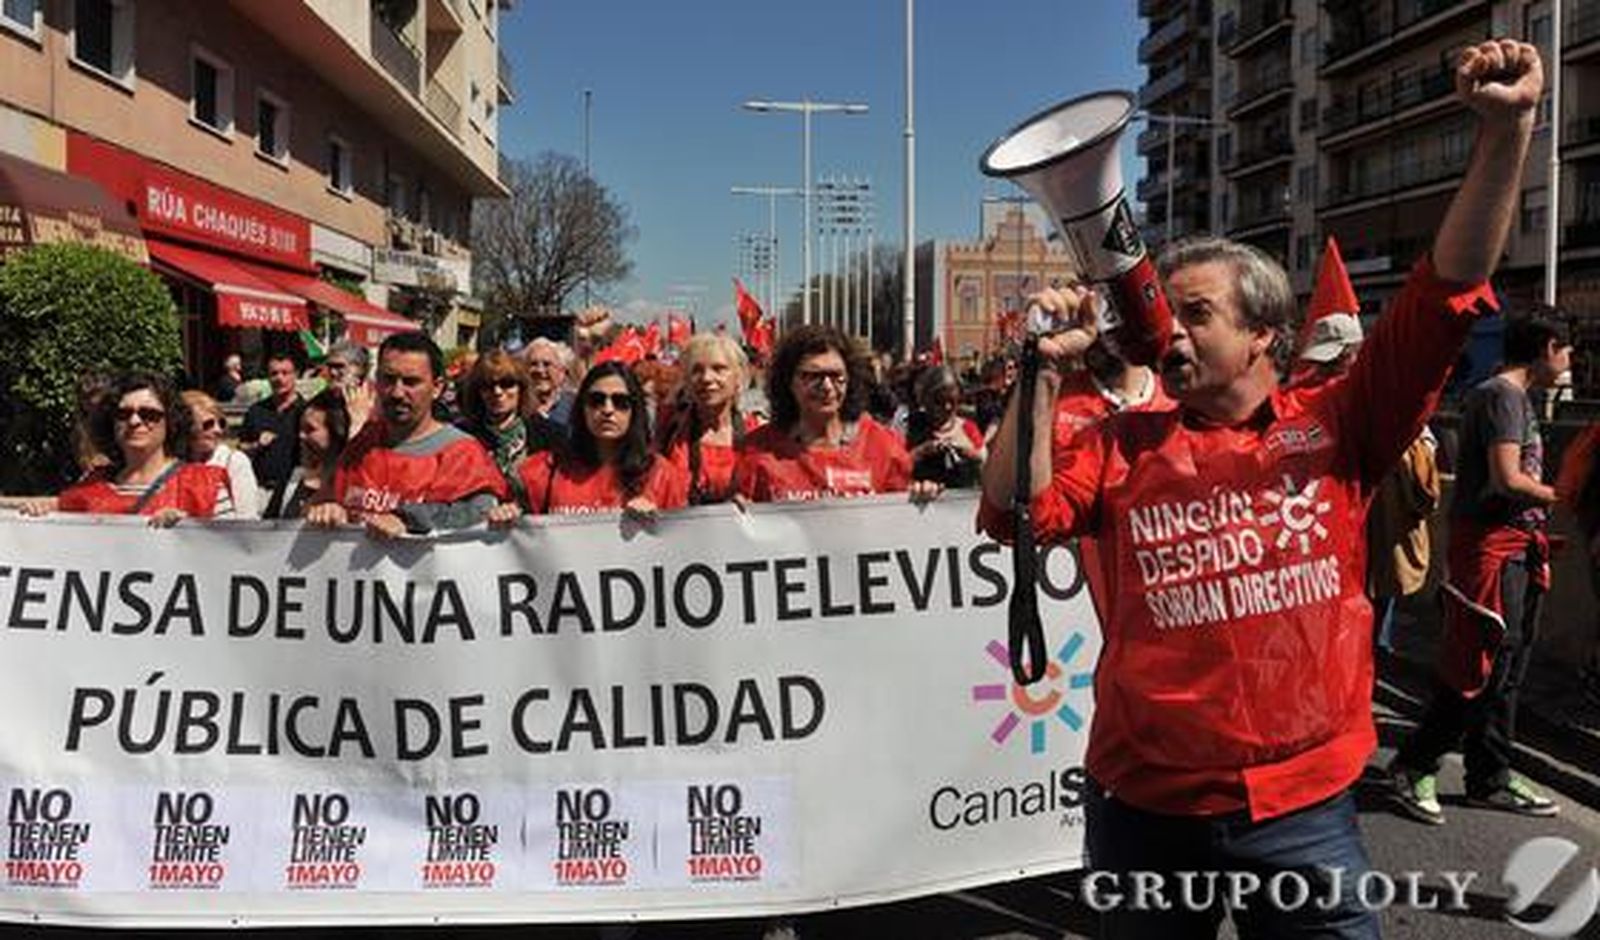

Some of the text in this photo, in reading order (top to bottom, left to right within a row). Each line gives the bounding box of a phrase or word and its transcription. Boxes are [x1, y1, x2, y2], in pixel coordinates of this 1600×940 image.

[147, 186, 187, 223] RÚA
[1129, 486, 1254, 544] NINGÚN
[1136, 528, 1263, 586] DESPIDO
[1145, 555, 1341, 629] SOBRAN DIRECTIVOS
[227, 575, 307, 640] DE
[326, 579, 476, 644] UNA
[64, 671, 825, 762] PÚBLICA DE CALIDAD
[8, 788, 72, 822] NO
[154, 792, 213, 824] NO
[293, 794, 349, 826] NO
[425, 794, 480, 826] NO
[556, 789, 611, 821] NO
[688, 784, 742, 818] NO
[7, 822, 90, 843] TIENEN
[153, 825, 230, 845] TIENEN
[292, 826, 366, 845] TIENEN
[426, 825, 498, 844] TIENEN
[557, 821, 629, 841] TIENEN
[688, 817, 761, 837] TIENEN
[6, 862, 83, 882] 1MAYO
[150, 865, 224, 883] 1MAYO
[286, 864, 360, 882] 1MAYO
[422, 863, 495, 882] 1MAYO
[554, 860, 627, 880] 1MAYO
[688, 856, 762, 876] 1MAYO
